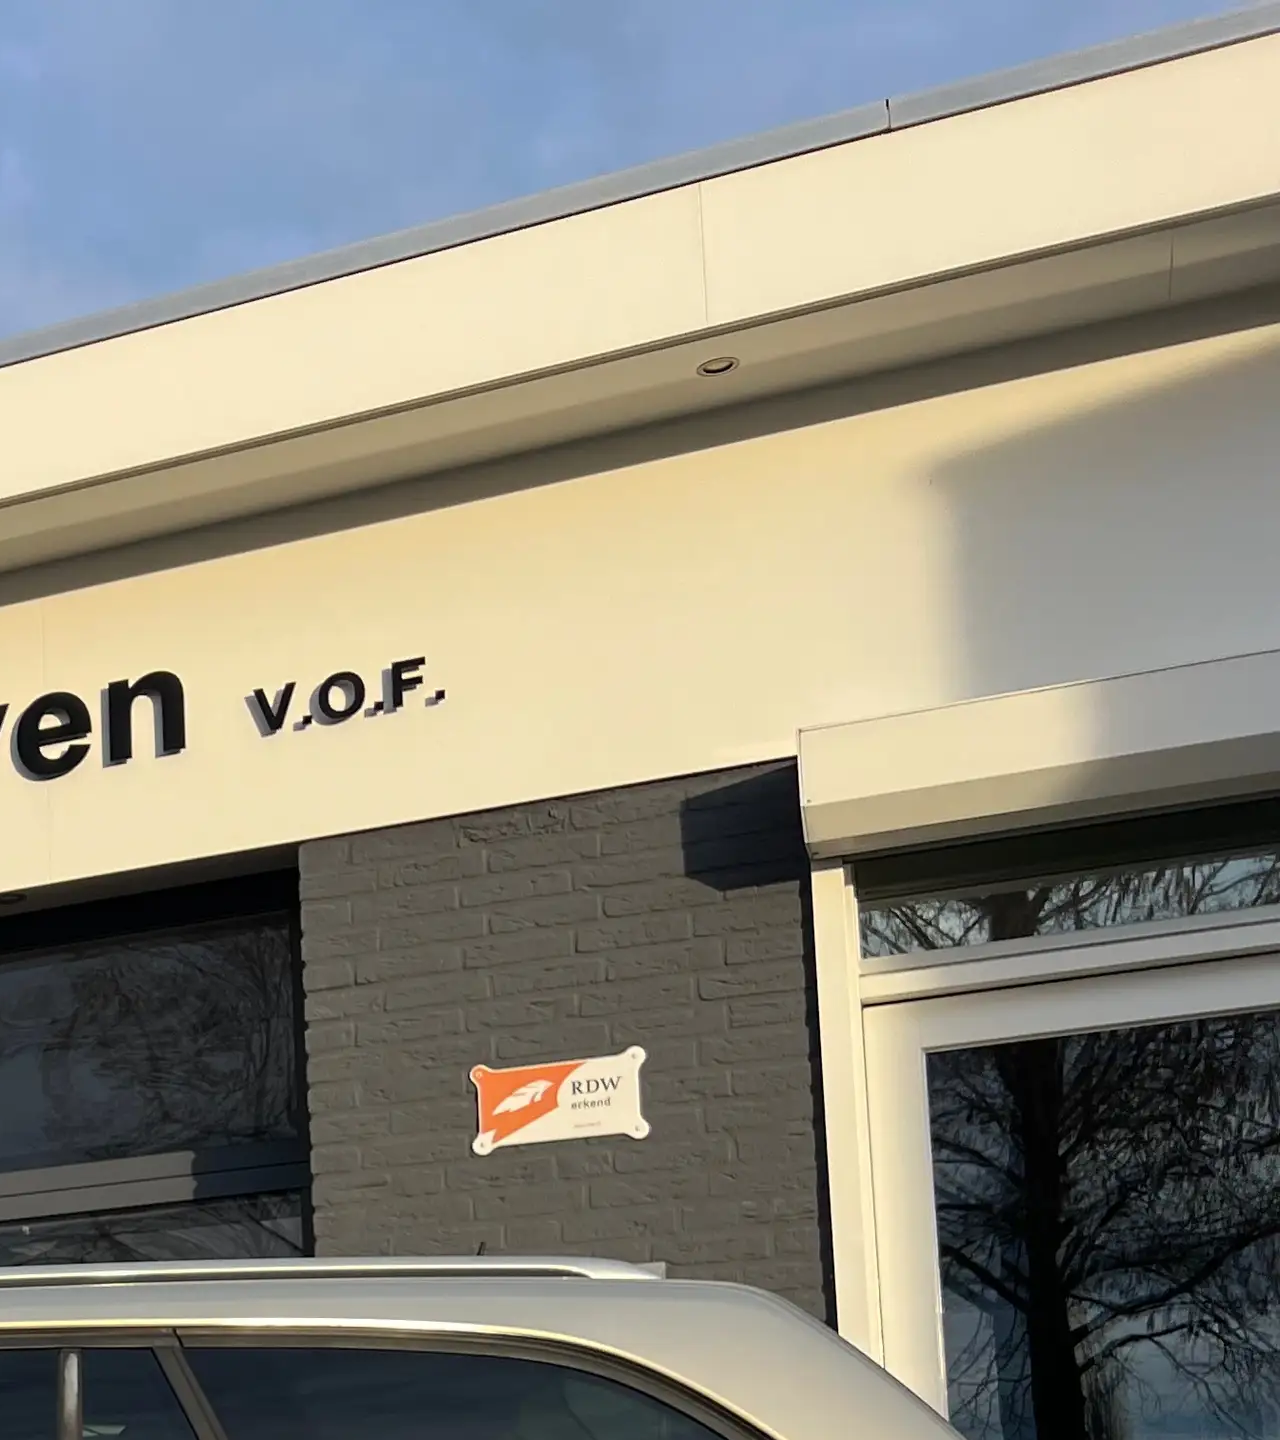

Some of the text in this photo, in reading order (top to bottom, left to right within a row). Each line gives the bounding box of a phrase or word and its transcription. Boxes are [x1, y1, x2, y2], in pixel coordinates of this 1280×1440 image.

[245, 656, 446, 737] V.O.F.
[571, 1075, 623, 1096] RDW
[570, 1097, 612, 1111] erkend
